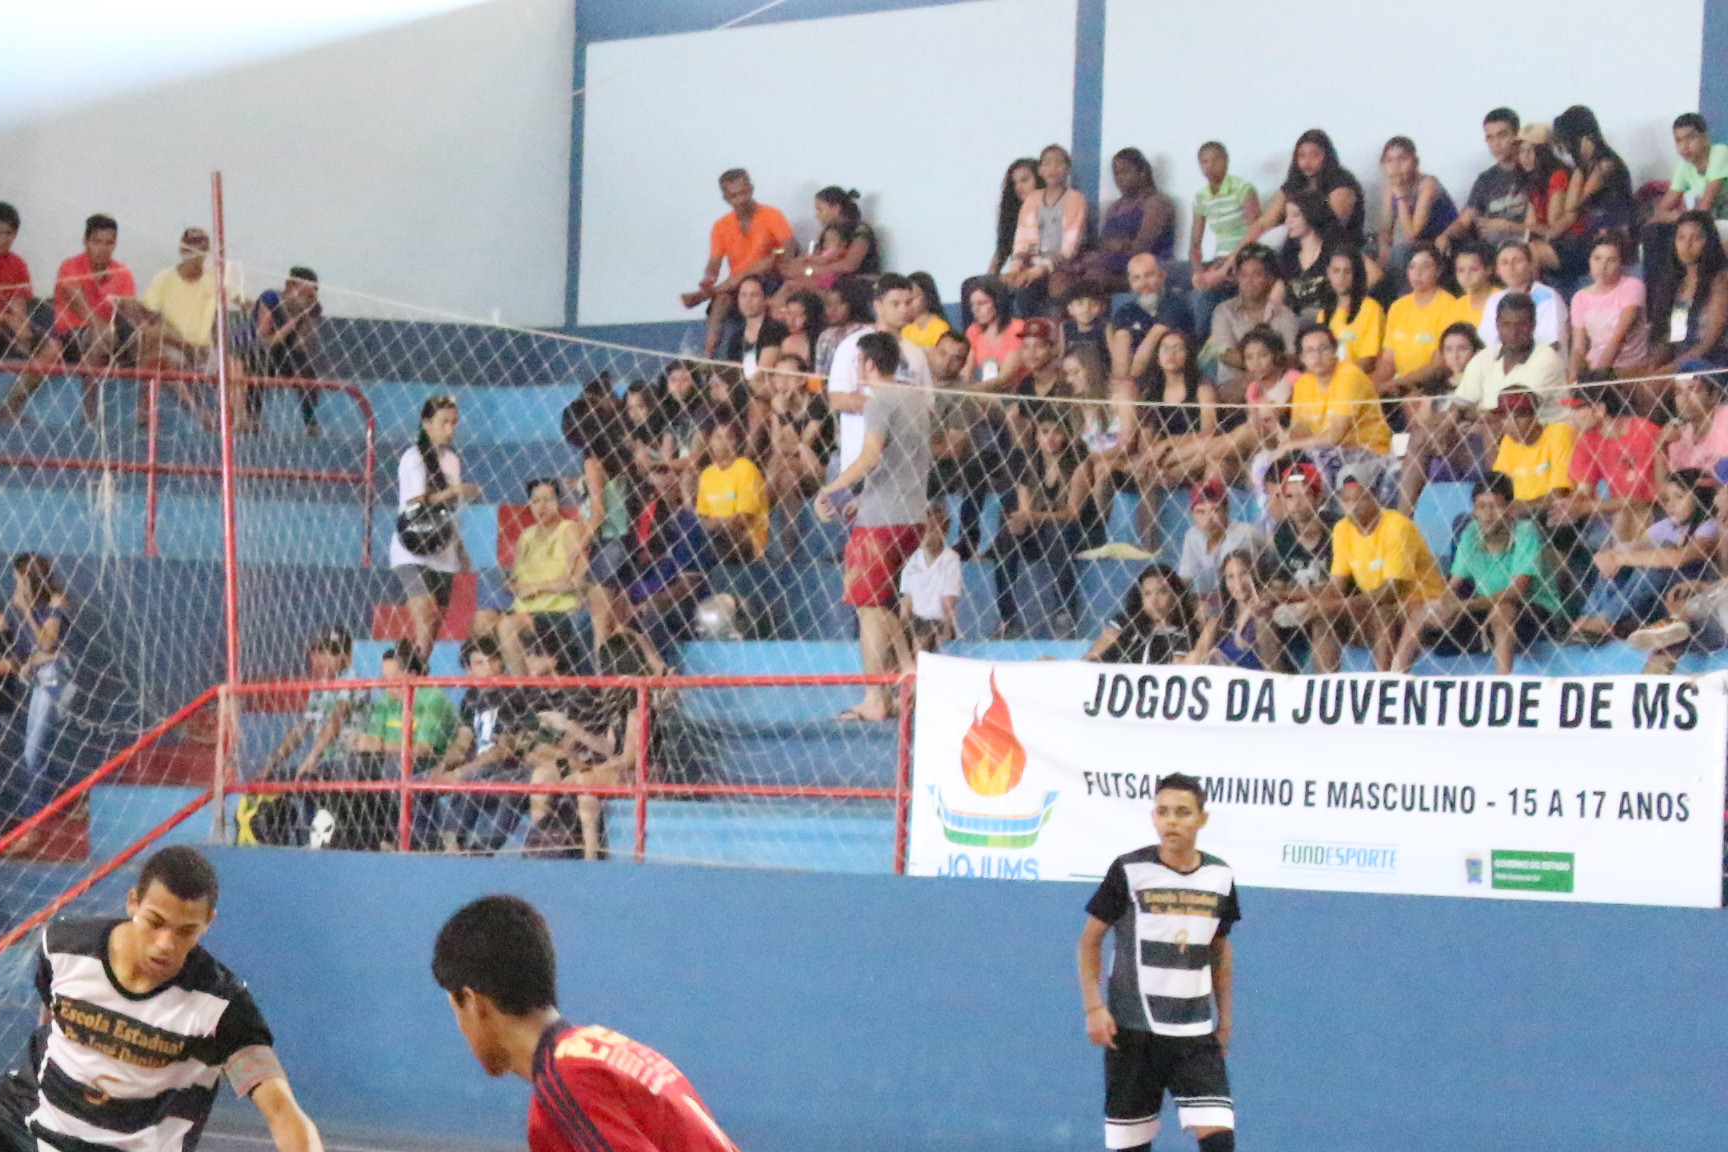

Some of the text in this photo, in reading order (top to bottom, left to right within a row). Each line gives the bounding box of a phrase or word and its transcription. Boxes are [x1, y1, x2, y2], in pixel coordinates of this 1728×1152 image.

[1083, 673, 1700, 731] JOGOS DA JUVENTUDE DE MS
[1192, 775, 1294, 806] MININO
[1304, 780, 1317, 807] E
[1326, 781, 1476, 814] MASCULINO
[1508, 788, 1538, 817] 15
[1548, 789, 1564, 817] A
[1576, 790, 1607, 819] 17
[1618, 791, 1691, 822] ANOS
[1282, 844, 1399, 870] FUNDESPORTE
[60, 1000, 185, 1055] Escola Estadual
